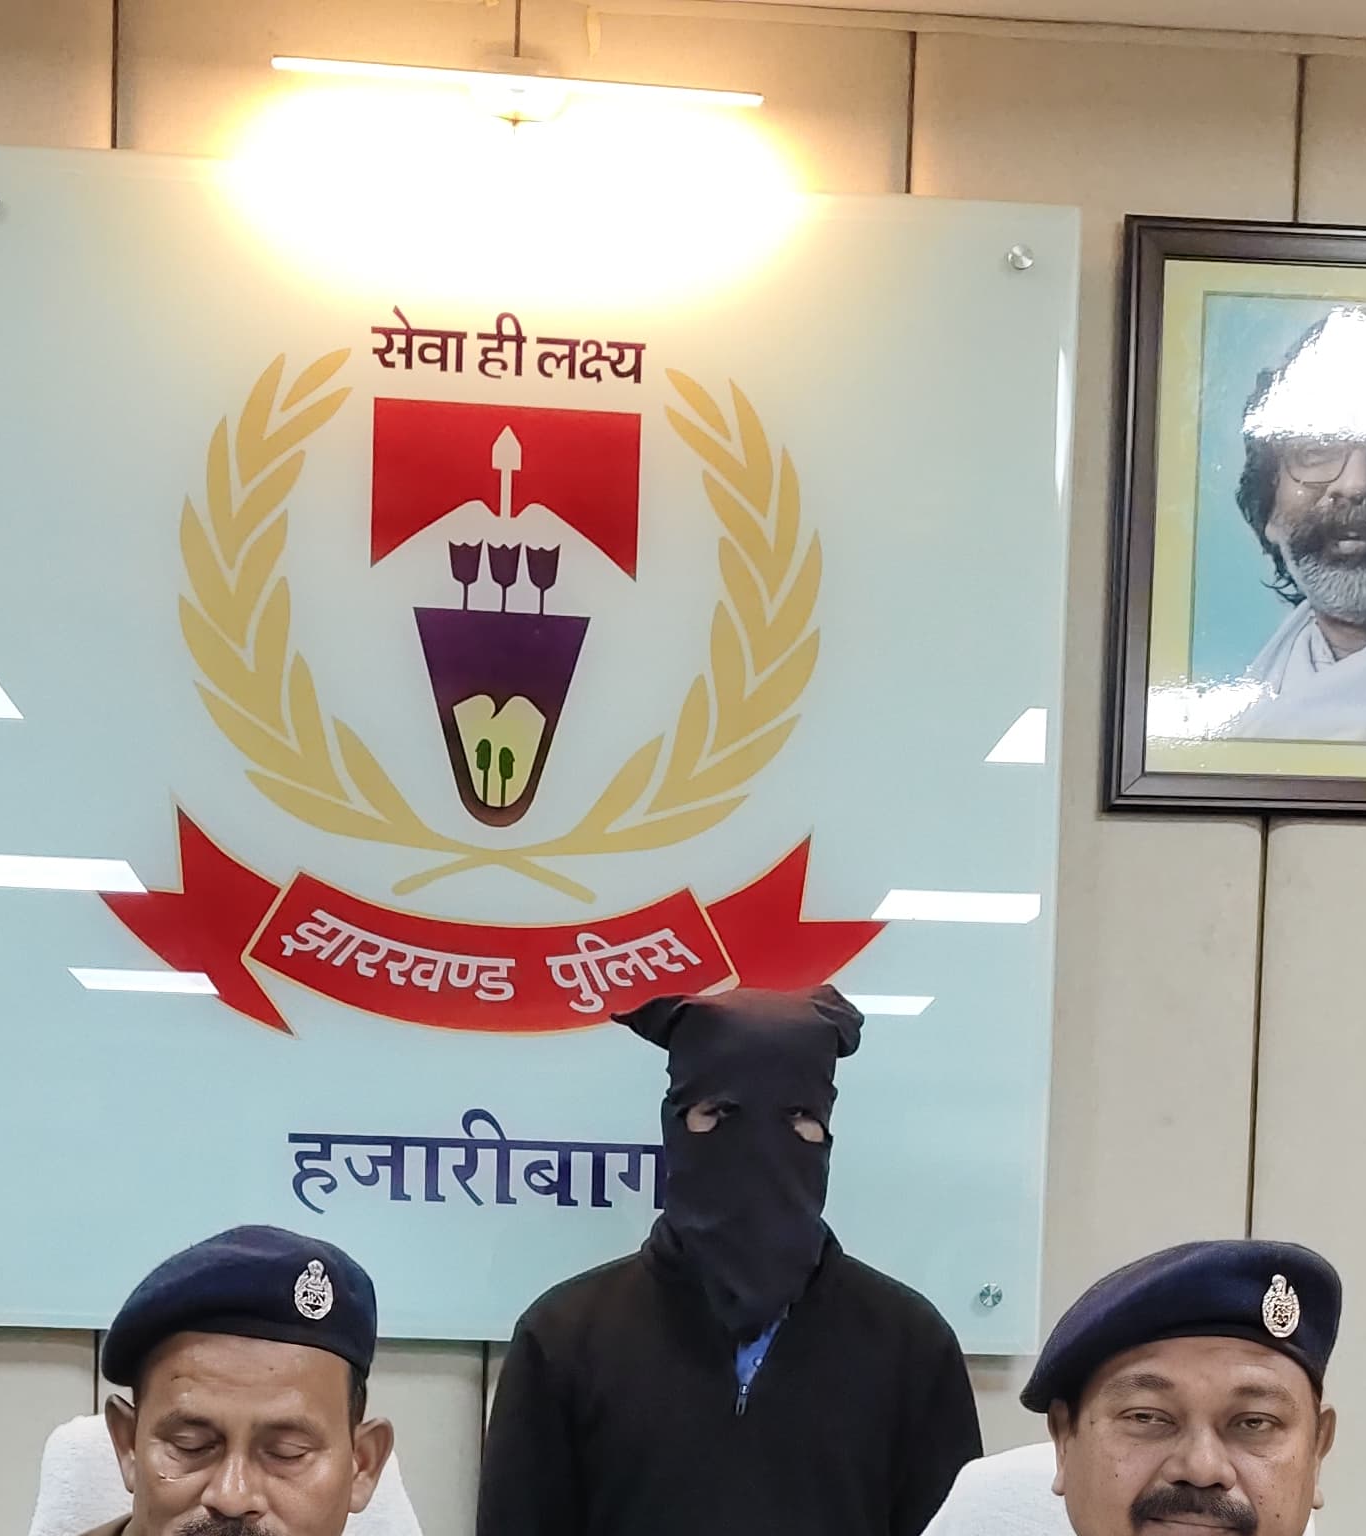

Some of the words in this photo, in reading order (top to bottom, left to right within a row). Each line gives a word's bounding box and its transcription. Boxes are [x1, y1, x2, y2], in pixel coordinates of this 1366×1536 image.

[370, 304, 468, 373] सेवा
[476, 312, 527, 380] ही
[536, 337, 646, 384] लक्ष्य
[280, 908, 516, 1001] झारखण्ड
[545, 927, 702, 1014] पुलिस
[287, 1108, 667, 1215] हजारीबाग
